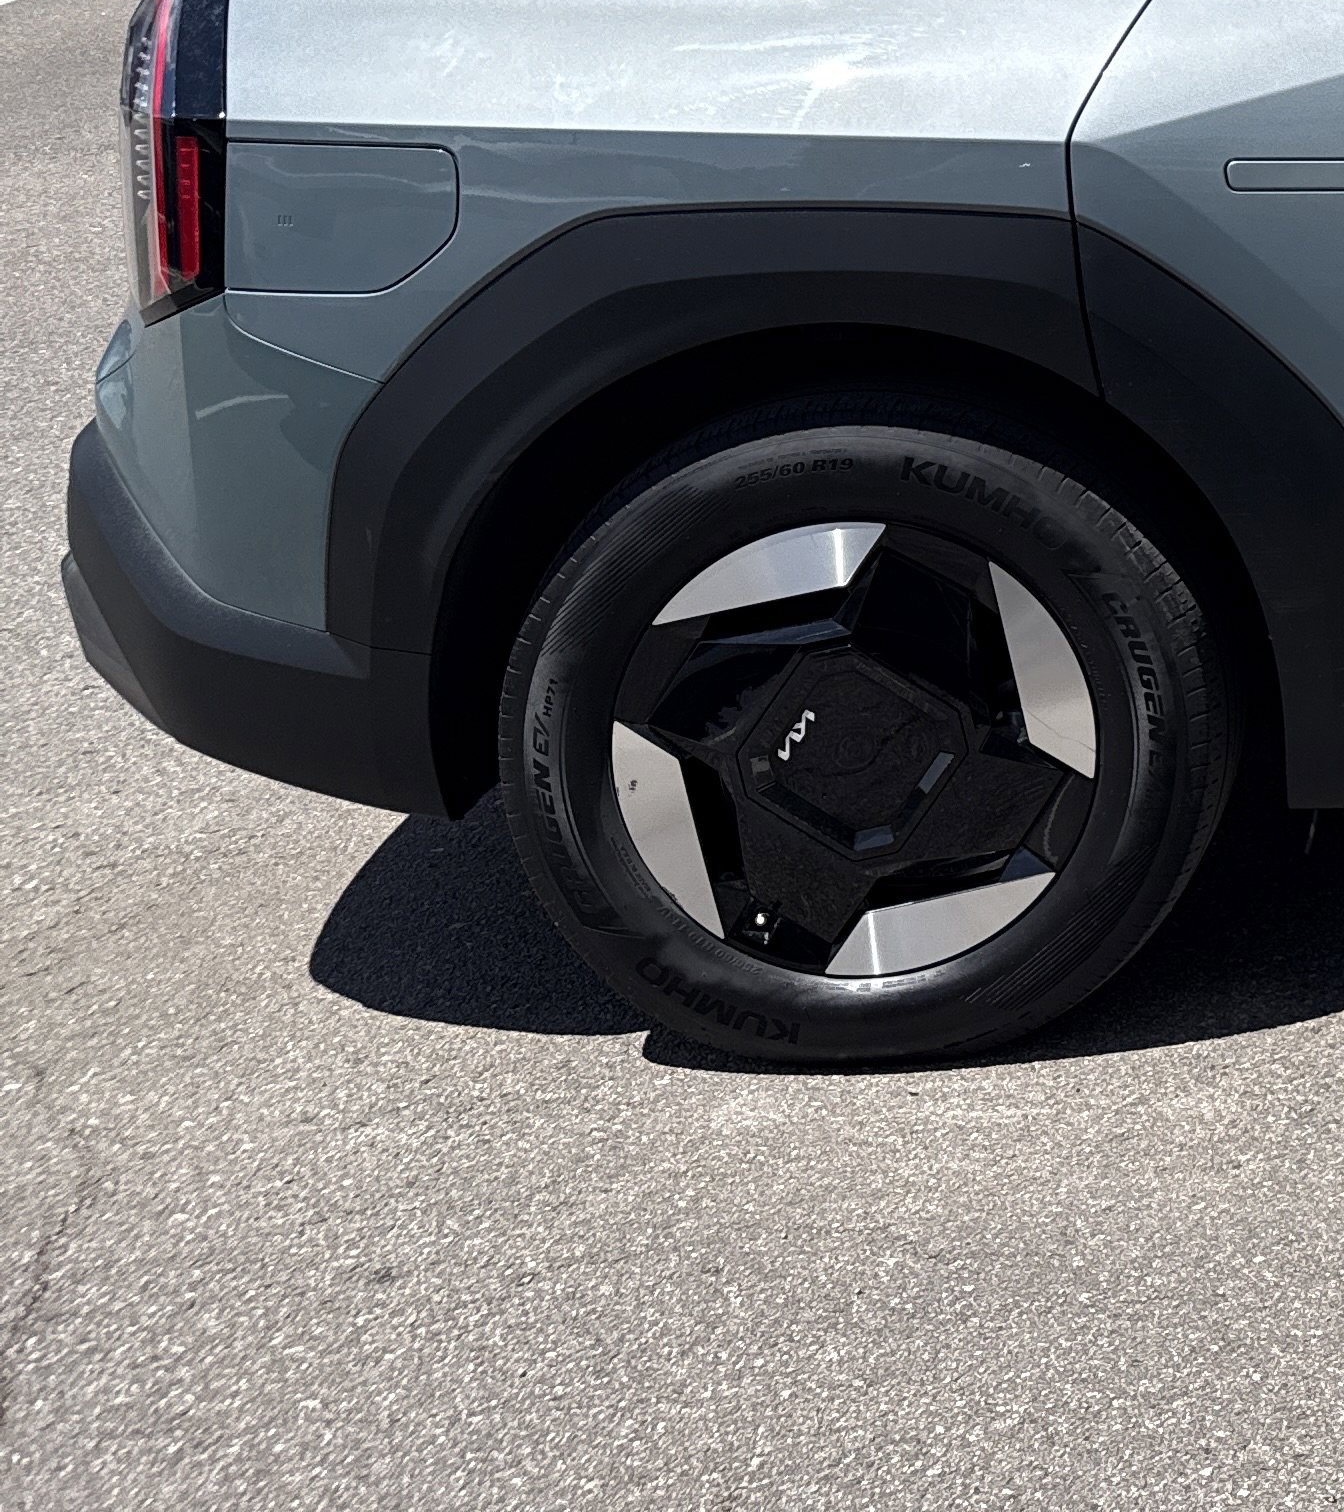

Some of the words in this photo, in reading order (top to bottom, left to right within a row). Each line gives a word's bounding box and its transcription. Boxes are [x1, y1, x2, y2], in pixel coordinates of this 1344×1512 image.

[734, 461, 805, 490] 255/60
[811, 458, 854, 472] R19
[900, 455, 1068, 551] KUMHO
[543, 678, 559, 718] HP71
[1101, 592, 1167, 746] CRUGEN
[636, 956, 801, 1045] KUMHO
